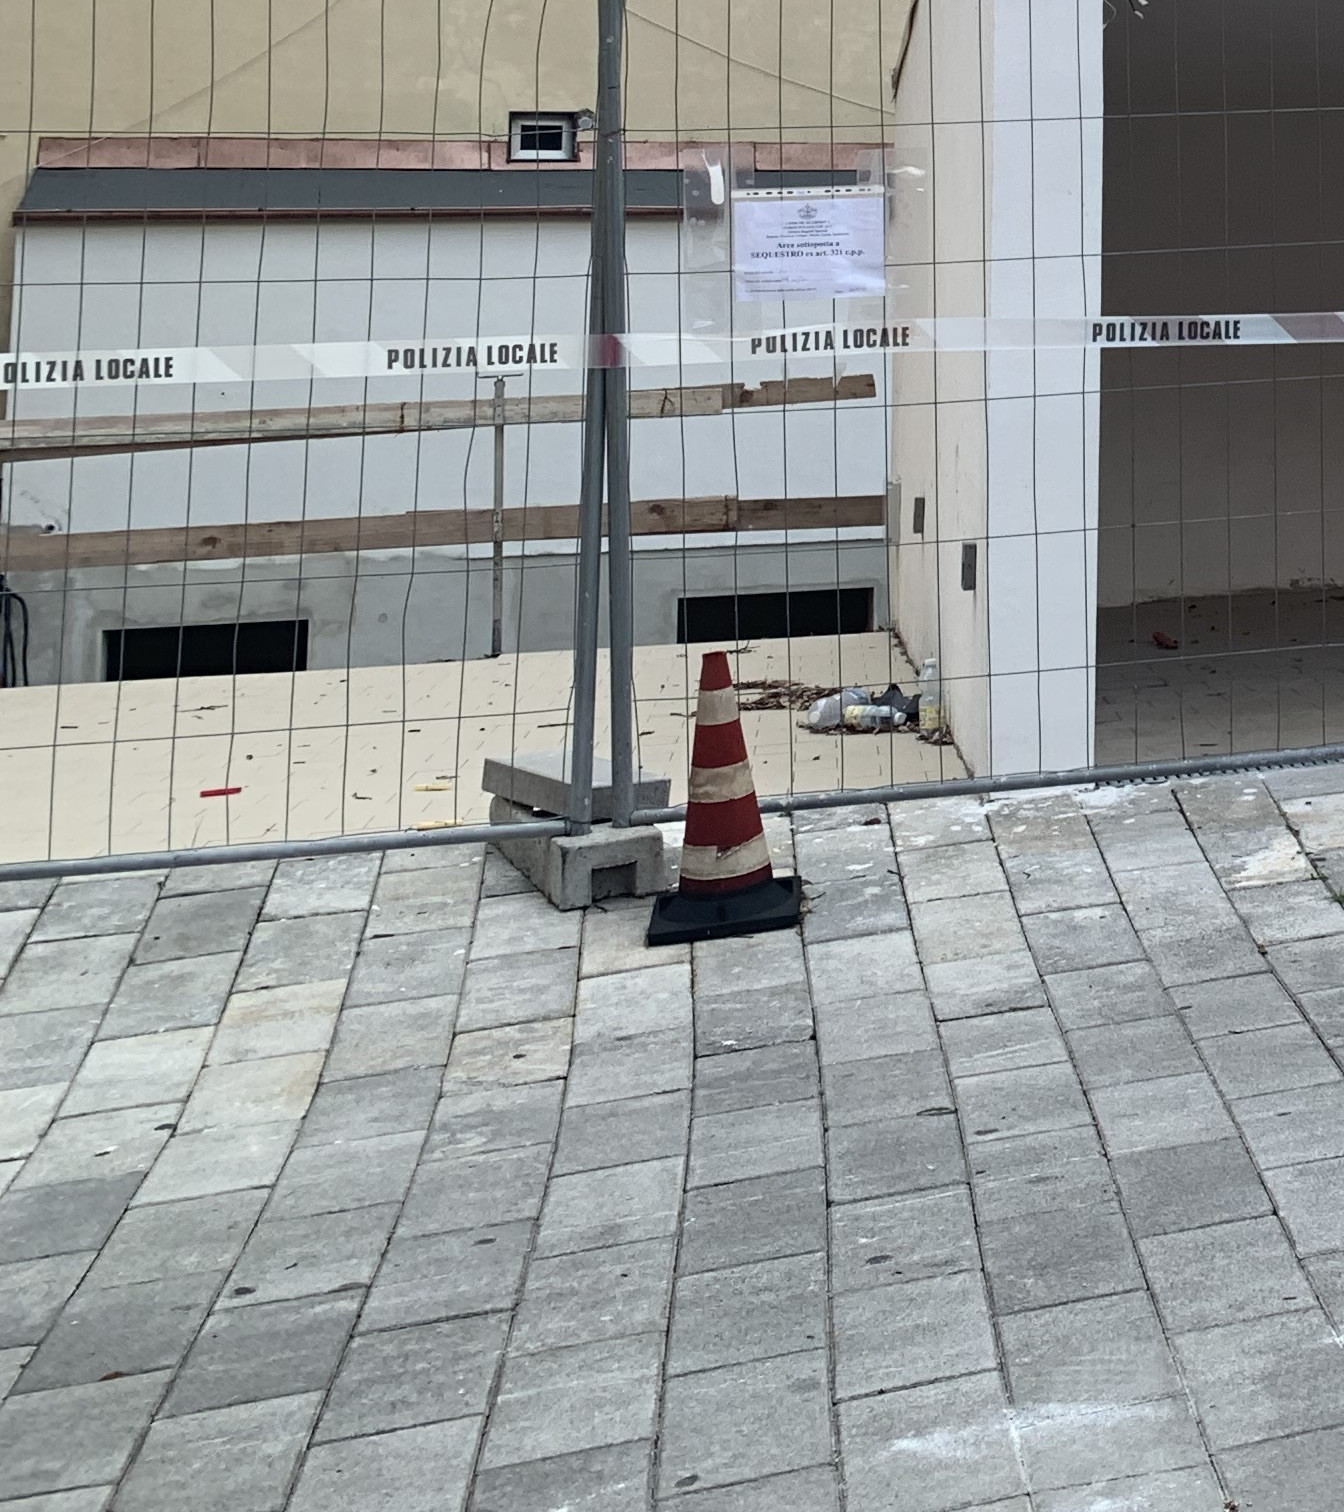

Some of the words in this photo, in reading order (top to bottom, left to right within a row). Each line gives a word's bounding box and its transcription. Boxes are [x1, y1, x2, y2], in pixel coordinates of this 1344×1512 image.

[750, 251, 803, 259] SEQUESTRO
[751, 330, 834, 354] POLIZIA
[842, 327, 909, 349] LOCALE
[1092, 321, 1170, 342] POLIZIA
[1178, 320, 1240, 340] LOCALE
[387, 346, 477, 369] POLIZIA
[487, 343, 558, 366] LOCALE
[3, 359, 84, 384] OLIZIA
[95, 356, 174, 380] LOCALE
